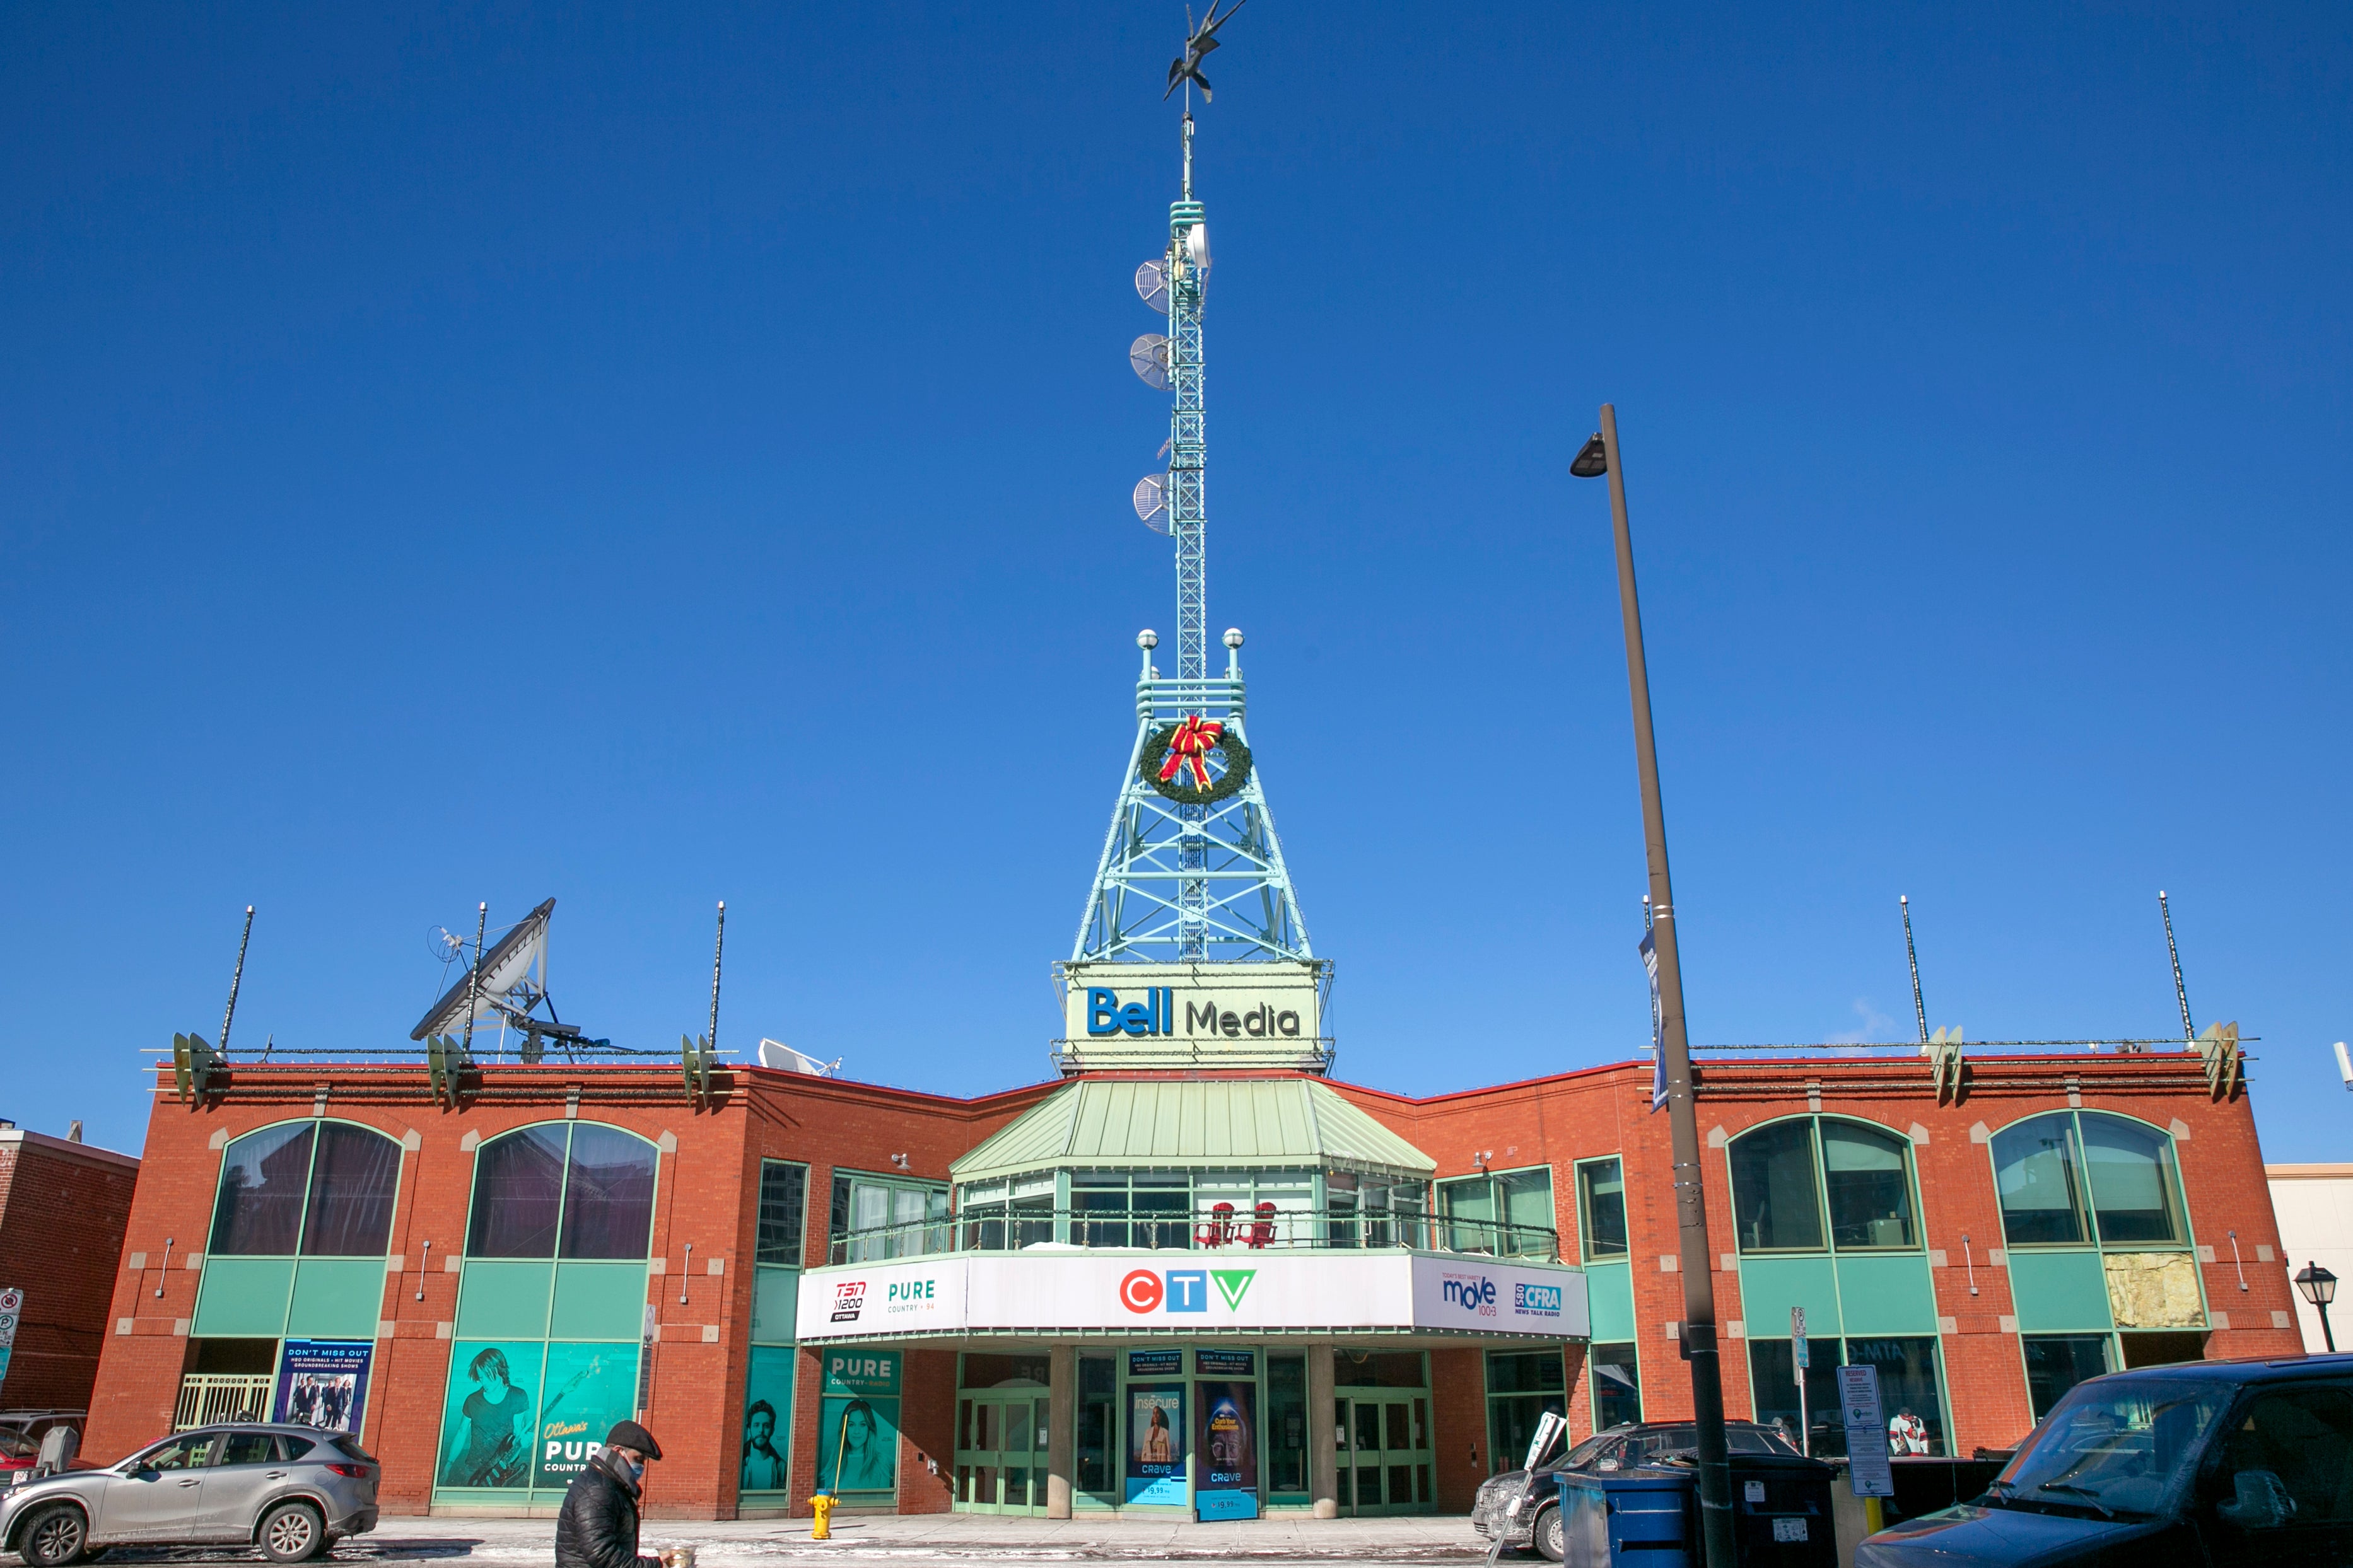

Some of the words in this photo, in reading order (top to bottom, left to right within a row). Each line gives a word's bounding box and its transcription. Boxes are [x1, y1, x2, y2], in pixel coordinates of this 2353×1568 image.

[1087, 986, 1172, 1035] Bell
[1186, 1001, 1300, 1037] Media
[836, 1281, 867, 1298] TSN
[889, 1280, 935, 1302] PURE
[1125, 1274, 1251, 1308] CTV
[1443, 1276, 1496, 1310] move
[1516, 1285, 1524, 1306] 580
[1525, 1286, 1560, 1308] CFRA
[838, 1298, 863, 1310] 1200
[888, 1304, 918, 1313] COUNTRY
[831, 1357, 892, 1378] PURE
[1135, 1396, 1179, 1409] insecure
[544, 1421, 588, 1439] Ottawa's
[544, 1463, 589, 1472] COUNTR
